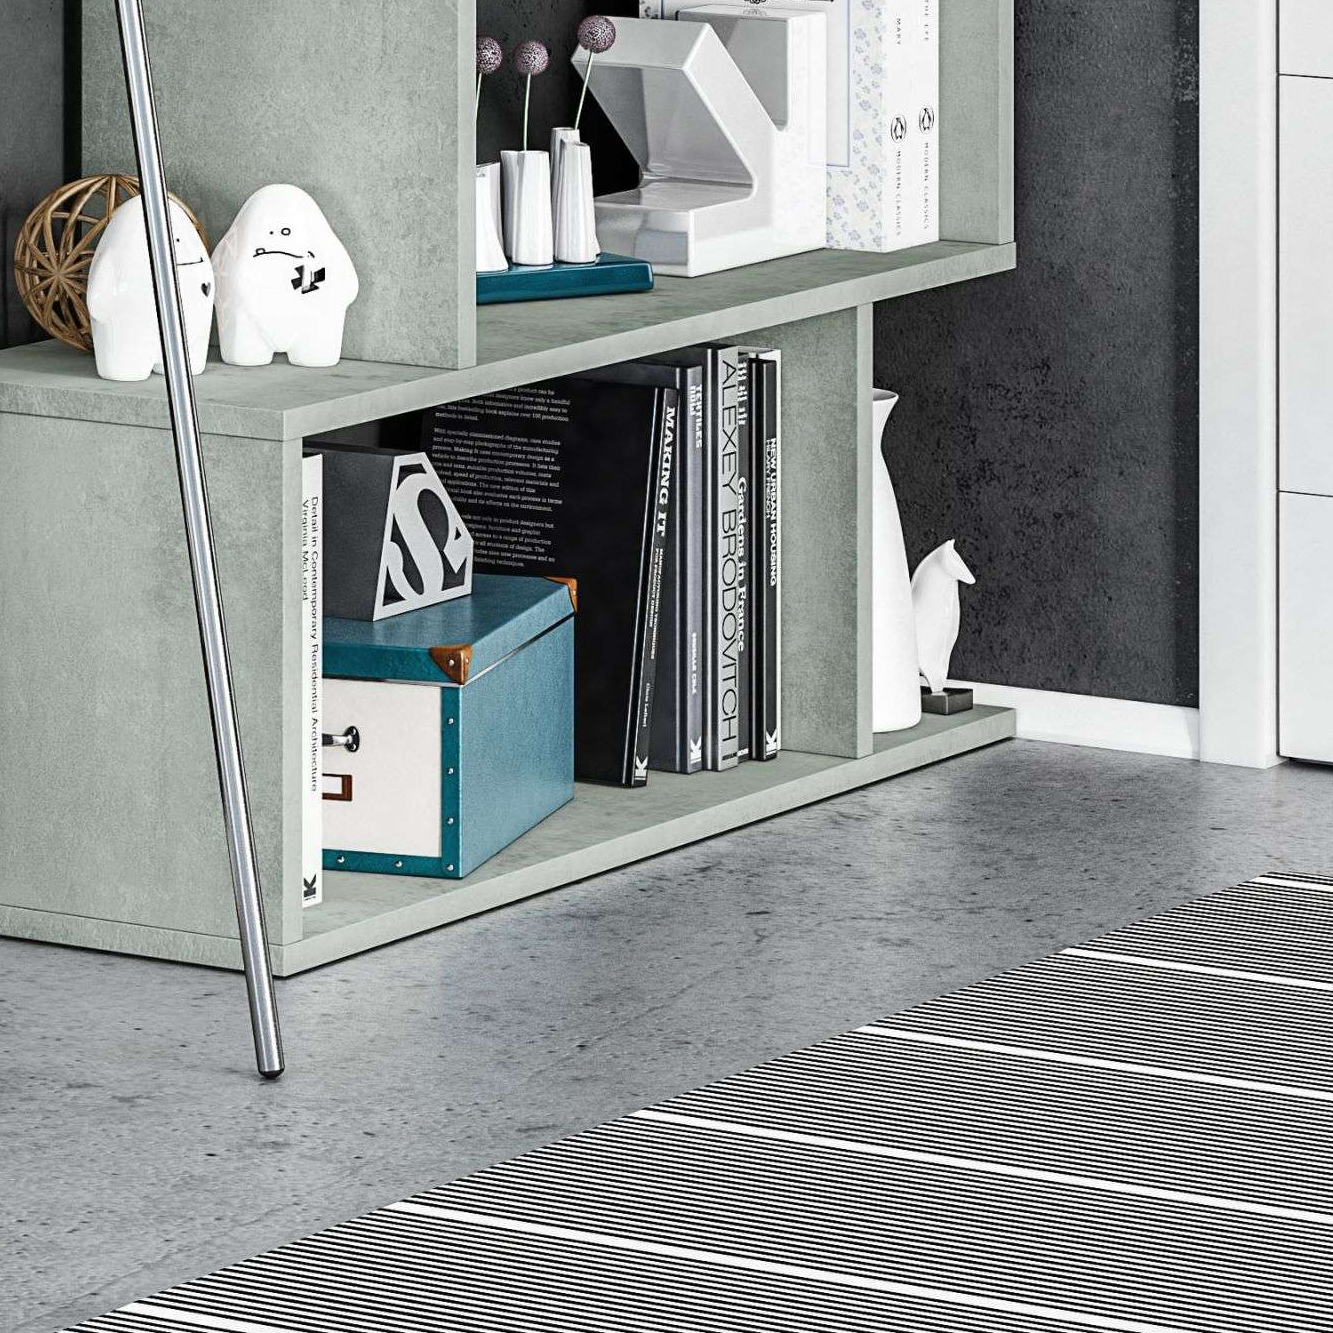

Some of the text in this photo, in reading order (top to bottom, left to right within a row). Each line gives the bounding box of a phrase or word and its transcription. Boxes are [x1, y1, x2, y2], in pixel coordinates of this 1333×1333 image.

[657, 406, 675, 537] MAKING IT
[722, 360, 737, 495] ALEXEY
[310, 551, 318, 639] Contemporary
[312, 536, 318, 547] in
[738, 477, 747, 652] Gardens in France
[311, 643, 319, 714] Residential
[722, 509, 737, 741] BRODOVITCH
[311, 718, 319, 791] Architecture
